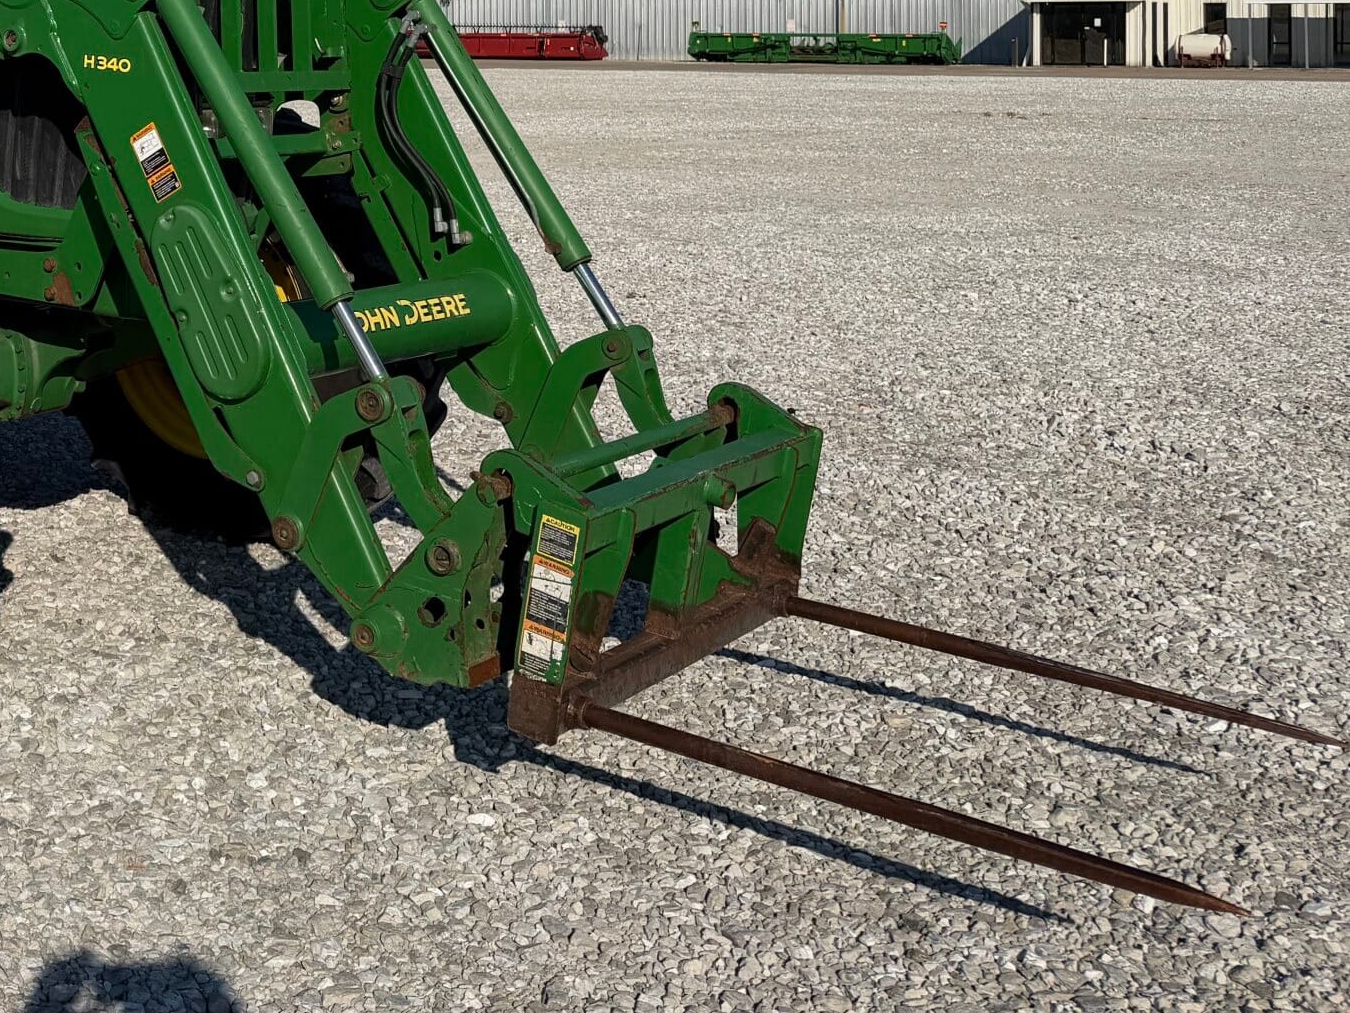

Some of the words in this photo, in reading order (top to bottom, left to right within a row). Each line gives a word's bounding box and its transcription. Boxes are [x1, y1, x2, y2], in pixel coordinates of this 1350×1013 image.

[83, 54, 131, 73] H340
[354, 305, 401, 334] OHN
[396, 293, 471, 326] DEERE
[542, 559, 570, 576] WARNING
